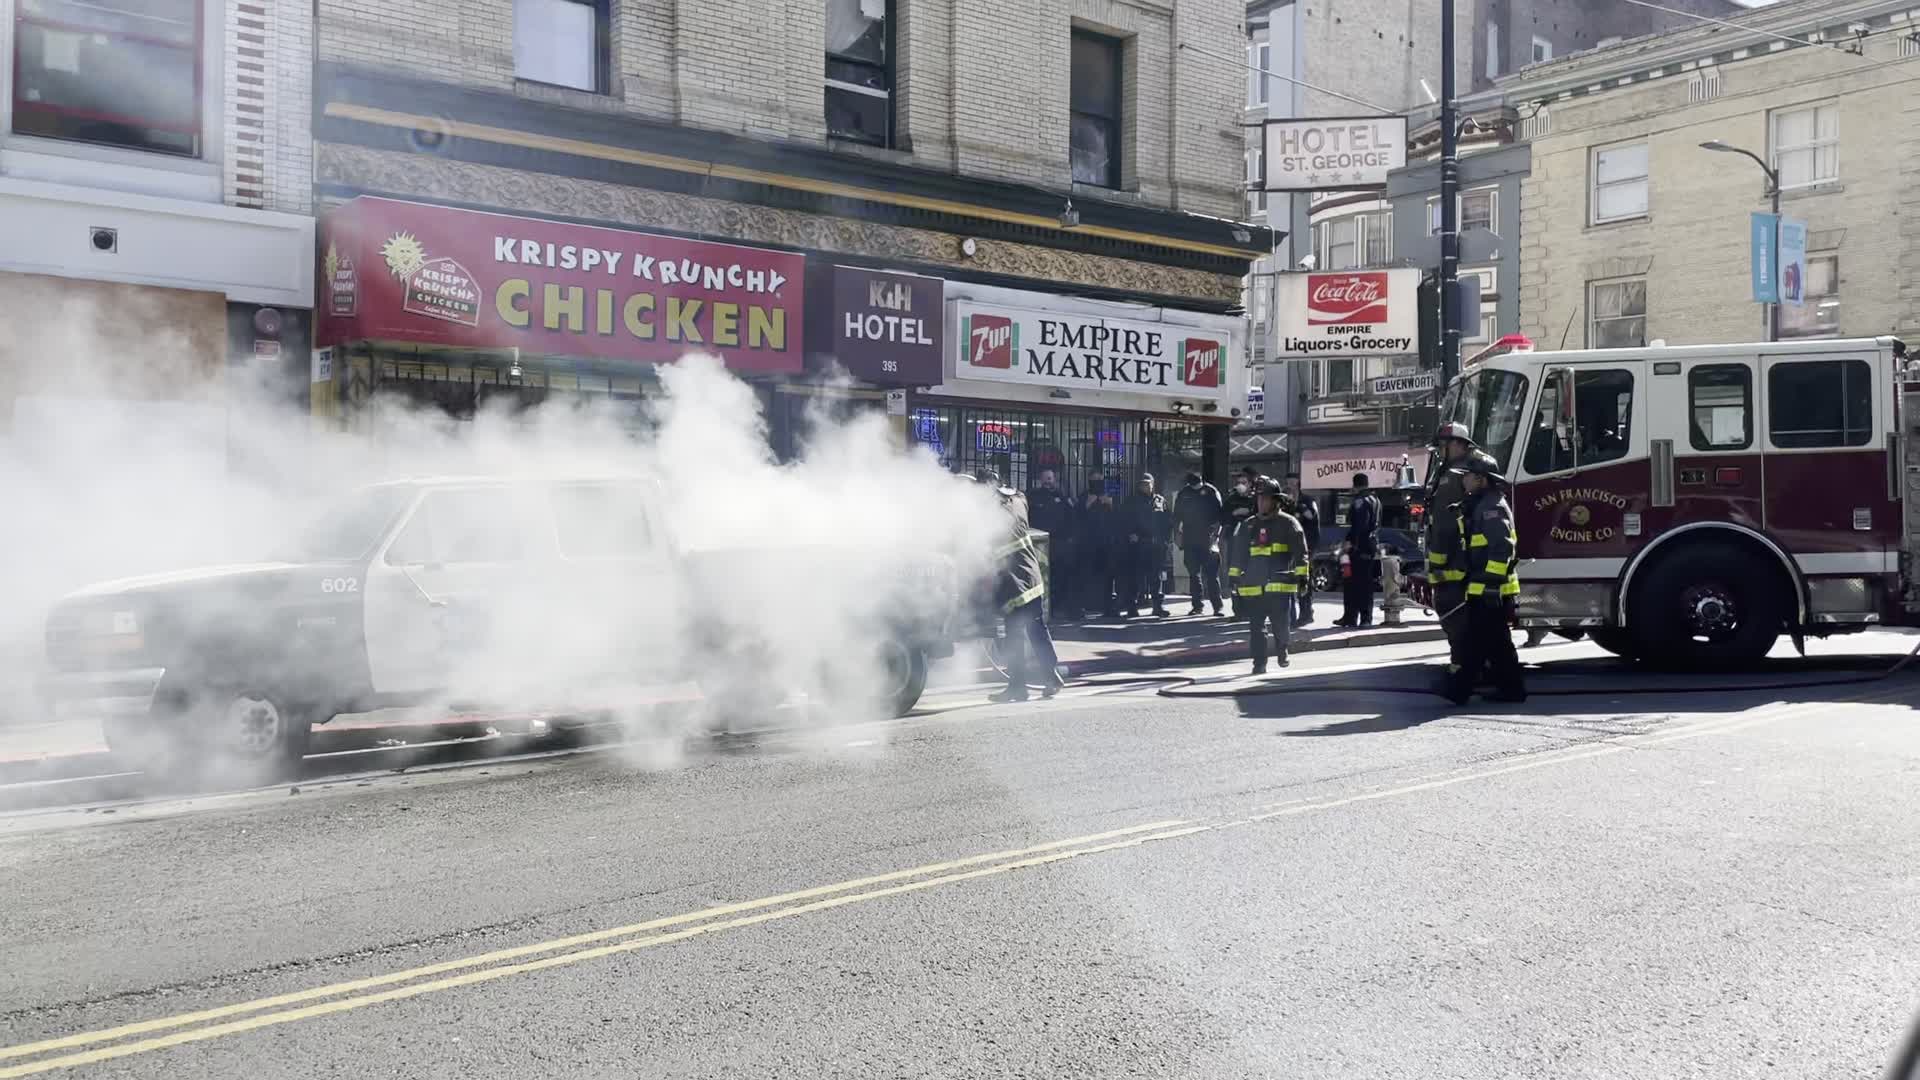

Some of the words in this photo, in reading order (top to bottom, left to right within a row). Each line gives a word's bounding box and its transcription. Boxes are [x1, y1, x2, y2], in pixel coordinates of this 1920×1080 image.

[1280, 125, 1392, 154] HOTEL
[1283, 157, 1309, 172] ST.
[1312, 152, 1390, 170] GEORGE
[495, 236, 622, 275] KRISPY
[633, 253, 787, 294] KRUNCHY
[413, 277, 475, 301] KRUNCHY
[422, 268, 469, 288] KRISPY
[416, 293, 470, 312] CHICKEN
[1313, 279, 1380, 304] Coca-Cola
[496, 278, 786, 350] CHICKEN
[845, 312, 933, 345] HOTEL
[1038, 319, 1163, 357] EMPIRE
[1327, 325, 1372, 335] EMPIRE
[882, 360, 897, 372] 395
[1025, 348, 1173, 386] MARKET
[1380, 460, 1402, 473] VIDE
[1535, 493, 1558, 510] SAN
[1560, 488, 1626, 509] FRANCISCO
[1550, 526, 1592, 542] ENGINE
[321, 577, 358, 592] 602
